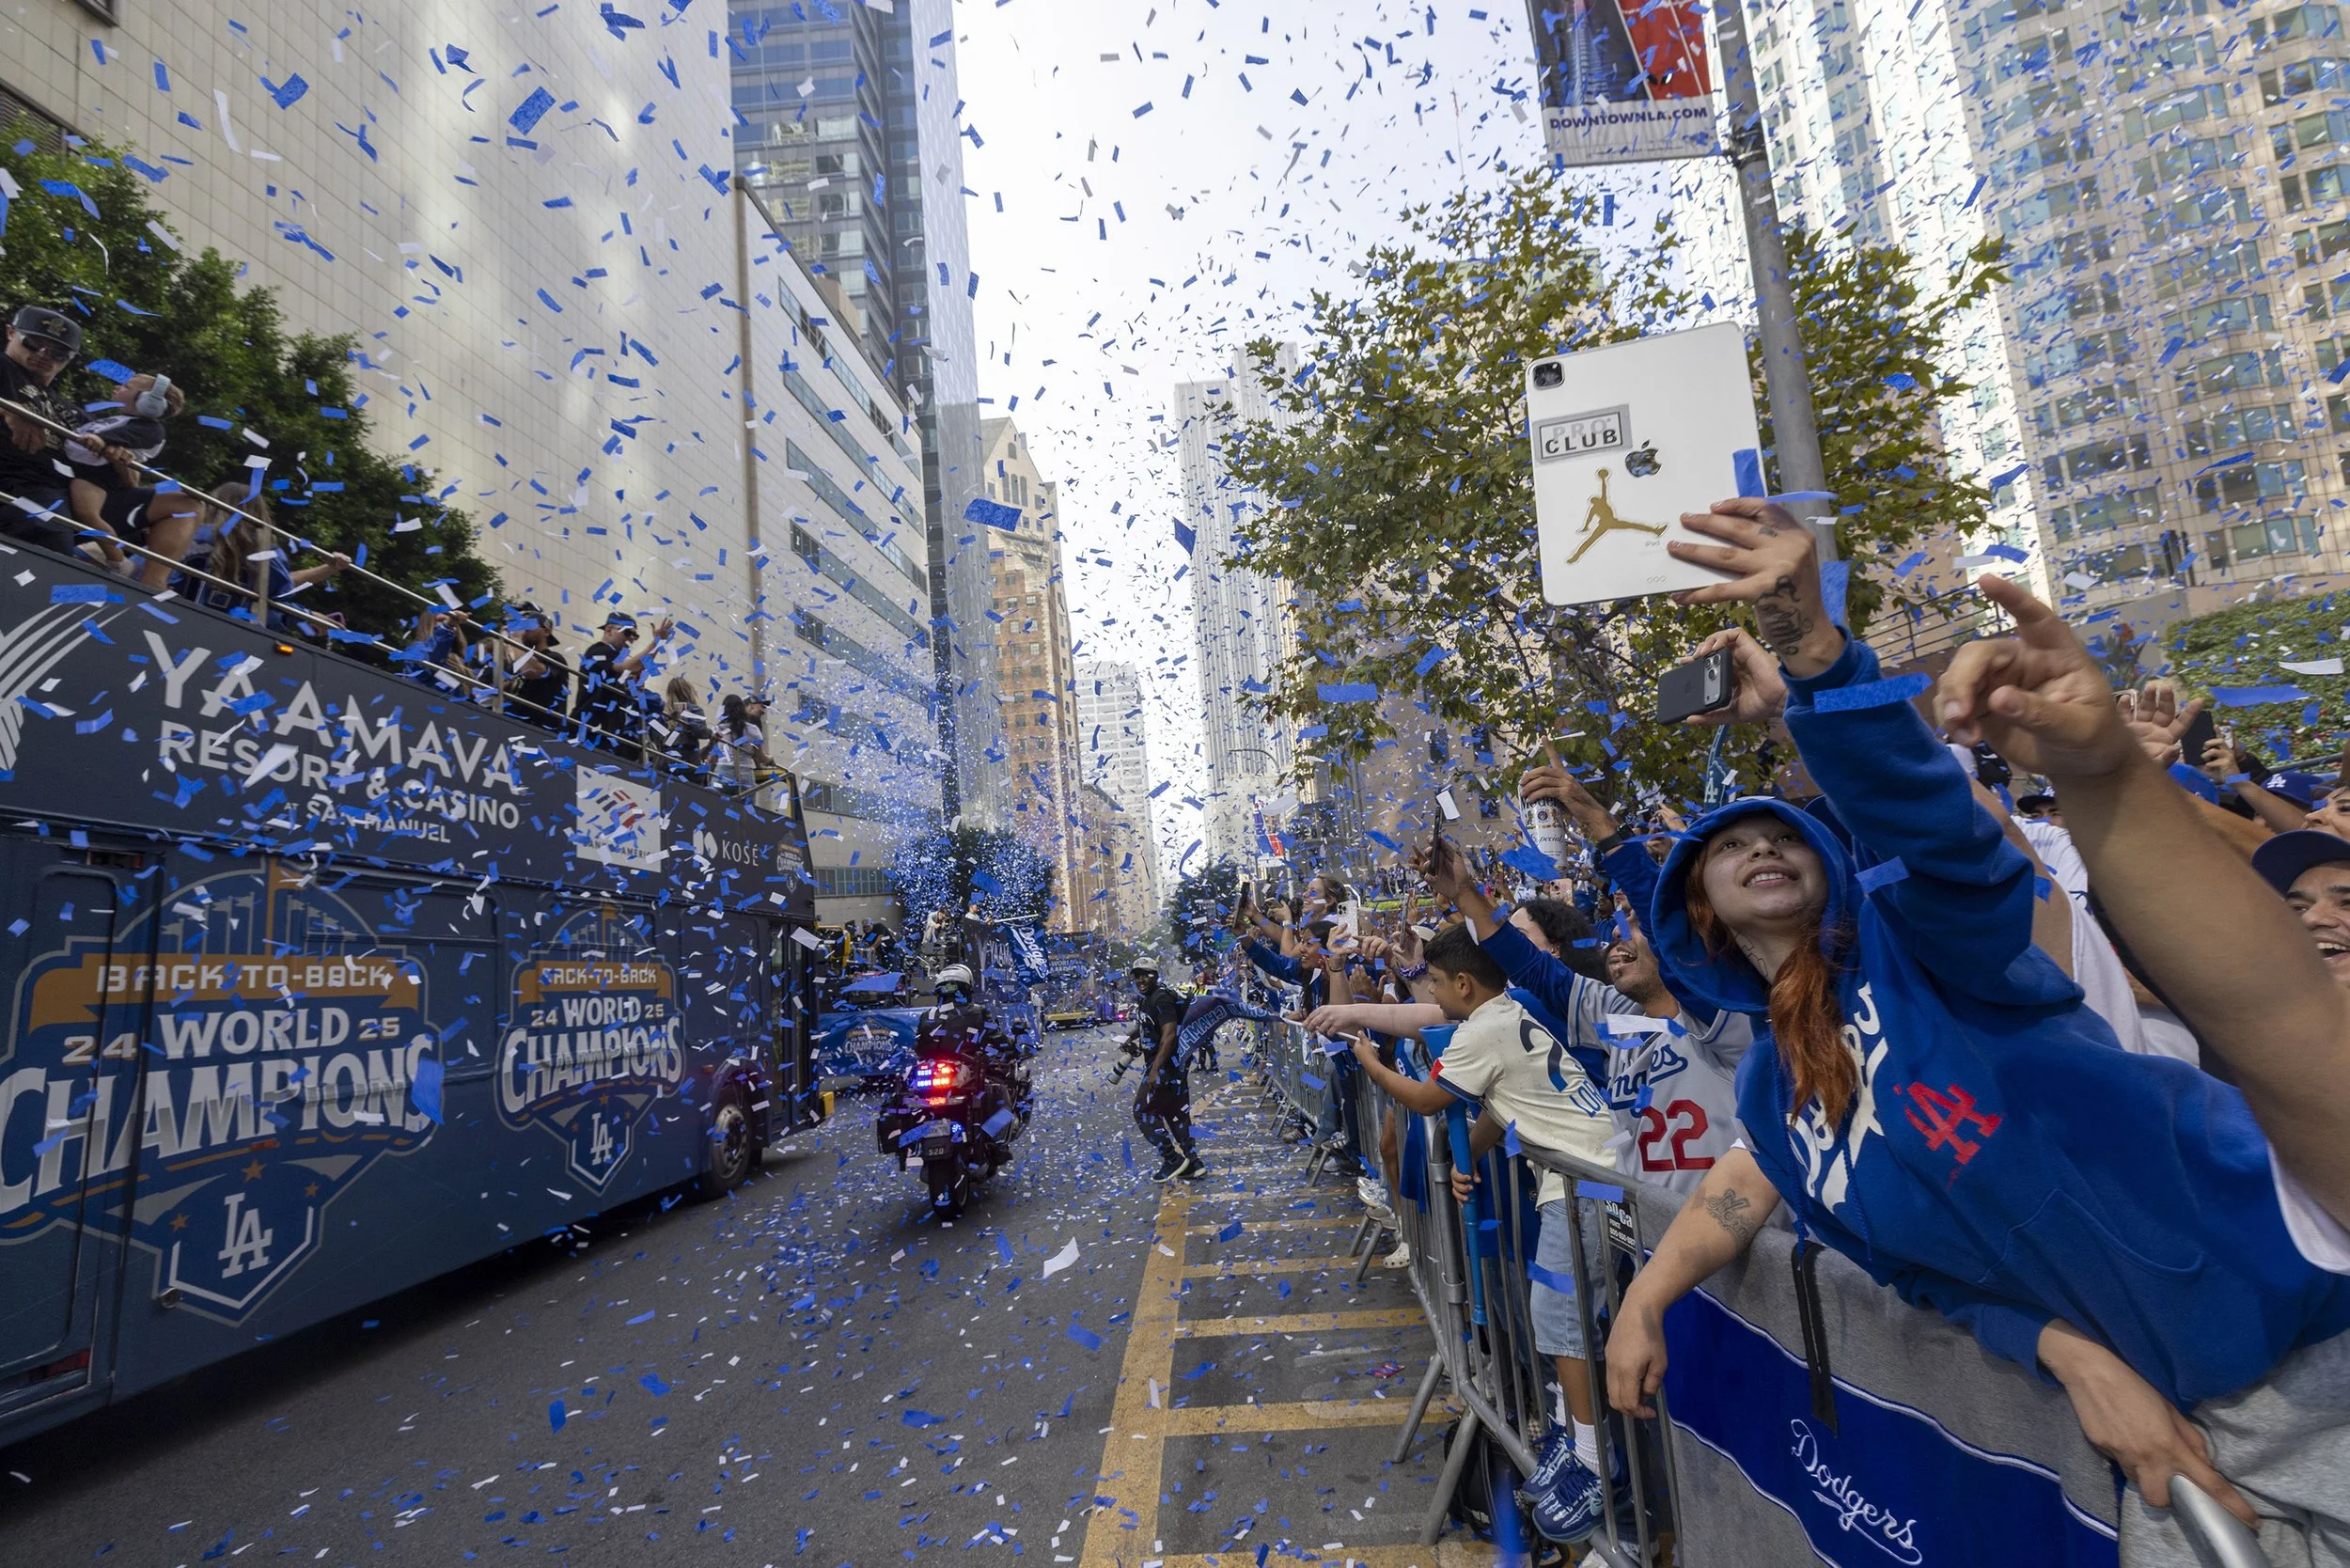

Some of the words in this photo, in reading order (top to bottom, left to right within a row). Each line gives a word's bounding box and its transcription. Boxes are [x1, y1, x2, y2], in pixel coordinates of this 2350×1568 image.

[1549, 106, 1708, 130] DOWNTOWNLA.COM
[1544, 429, 1618, 454] CLUB
[1553, 418, 1606, 441] PRO
[159, 720, 354, 794] RESORT
[366, 768, 389, 801] &
[402, 779, 520, 829] CASINO
[364, 812, 451, 843] MANUEL
[722, 839, 760, 867] KOSÉ
[96, 964, 386, 994] BACK-TO-BACK
[541, 965, 658, 986] BACK-TO-BACK
[530, 1009, 558, 1028] 24
[561, 996, 642, 1028] WORLD
[644, 1002, 665, 1019] 25
[62, 1033, 137, 1065] 24
[158, 1006, 350, 1060] WORLD
[357, 1016, 401, 1041] 25
[844, 1038, 894, 1052] CHAMPIONS
[501, 1015, 682, 1114] CHAMPIONS
[0, 1033, 445, 1215] CHAMPIONS
[590, 1112, 614, 1167] LA
[1637, 1099, 1716, 1172] 22
[217, 1192, 274, 1279] LA
[1791, 1419, 1922, 1565] Dodgers
